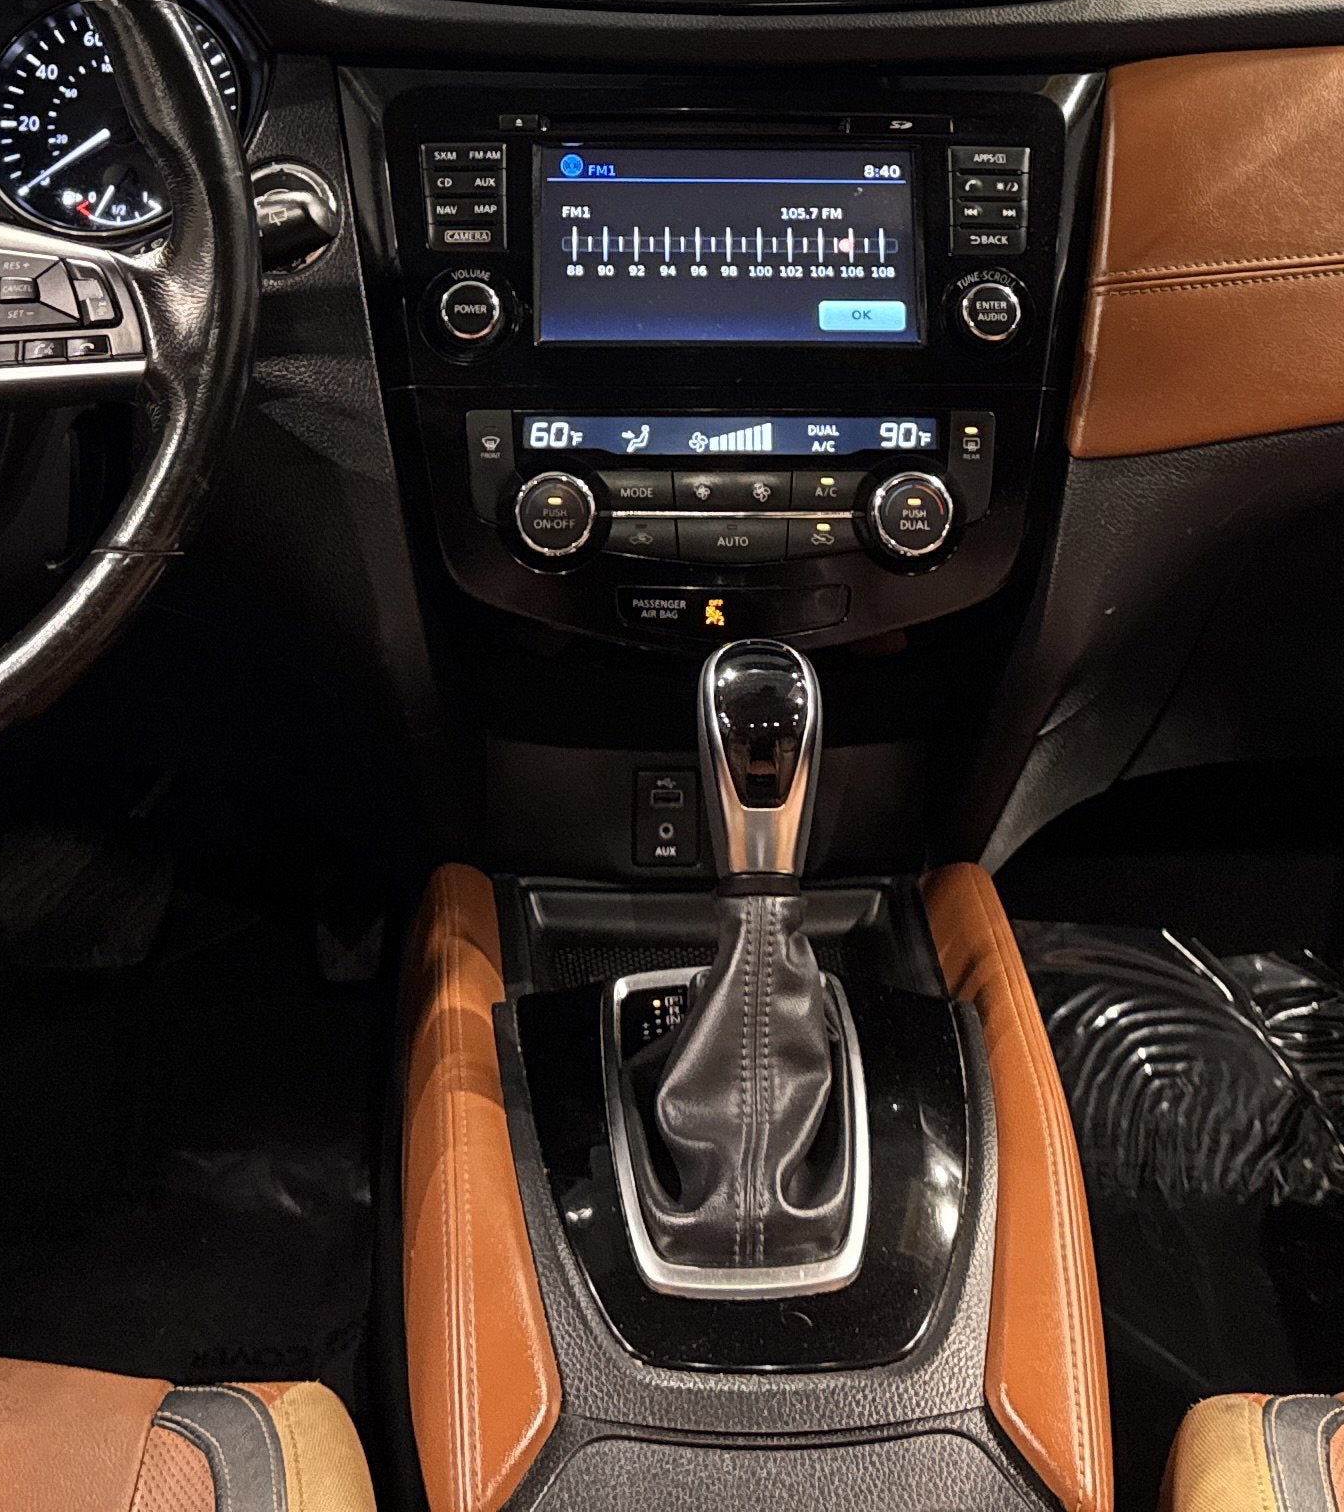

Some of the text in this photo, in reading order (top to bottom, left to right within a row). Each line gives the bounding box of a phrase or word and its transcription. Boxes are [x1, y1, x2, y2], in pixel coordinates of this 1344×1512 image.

[35, 64, 58, 80] 40
[18, 115, 40, 132] 20
[56, 134, 68, 144] 20
[434, 151, 456, 160] SXM
[588, 164, 900, 178] FM1 8:40
[437, 178, 496, 187] CD AUX
[112, 204, 126, 216] 1/2
[436, 205, 497, 215] NAV MAP
[561, 205, 843, 219] FM1 105.7 FM
[446, 232, 489, 240] CAMERA
[981, 235, 1008, 245] BACK
[3, 261, 20, 270] RES
[451, 269, 491, 281] VOLUME
[566, 264, 895, 278] 88 90 92 94 96 98 100 102 104 106 108
[2, 284, 32, 293] CANCEL
[454, 304, 487, 314] POWER
[976, 301, 1007, 310] ENTER
[7, 310, 24, 319] SET
[851, 310, 872, 320] OK
[977, 313, 1008, 322] AUDIO
[807, 424, 839, 436] DUAL
[811, 440, 836, 453] A/C
[620, 488, 654, 498] MODE
[815, 487, 838, 498] A/C
[542, 509, 568, 518] PUSH
[902, 509, 927, 518] PUSH
[899, 520, 931, 531] DUAL
[717, 536, 749, 547] AUTO
[632, 599, 686, 609] PASSENGER
[641, 609, 678, 619] AIR BAG
[655, 846, 677, 857] AUX
